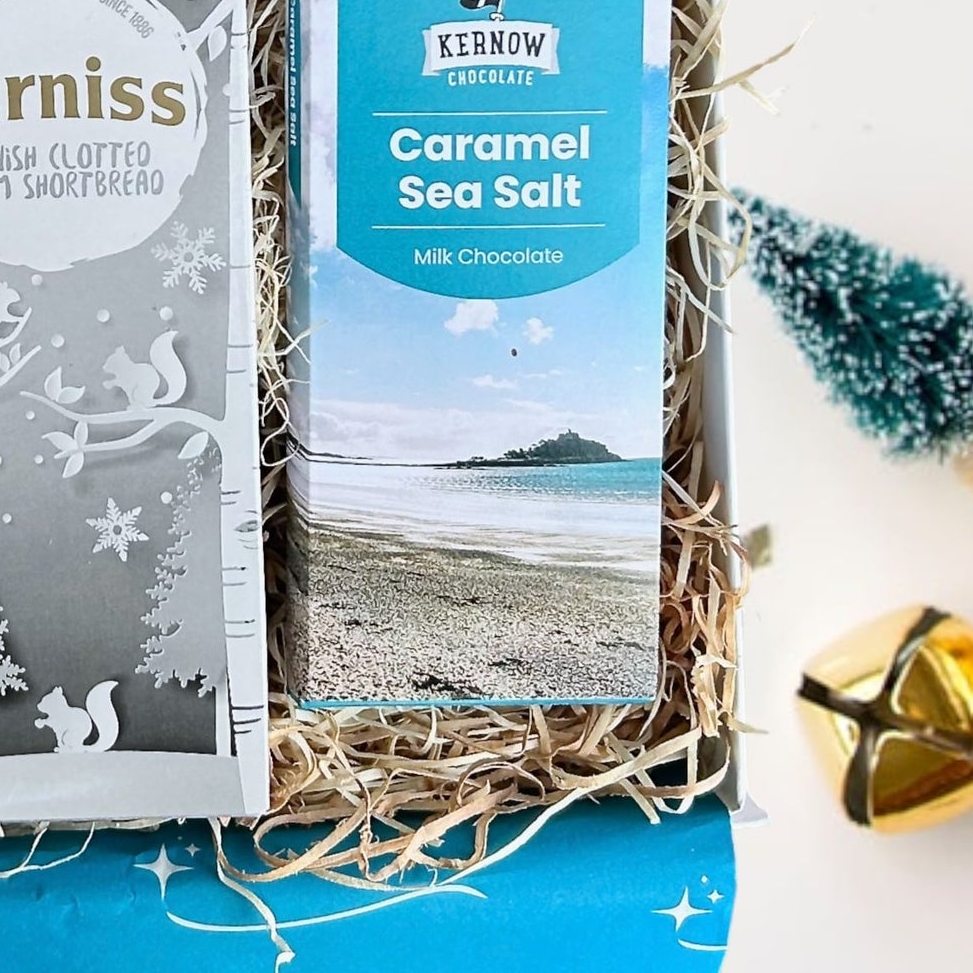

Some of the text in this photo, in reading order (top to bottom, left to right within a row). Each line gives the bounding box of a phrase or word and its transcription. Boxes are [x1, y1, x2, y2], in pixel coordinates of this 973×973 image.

[128, 11, 155, 39] 1886
[437, 30, 546, 59] KERNOW
[289, 75, 297, 109] Sea
[447, 69, 534, 87] CHOCOLATE
[289, 111, 297, 147] Salt
[389, 124, 590, 162] Caramel
[48, 141, 151, 170] CLOTTED
[23, 169, 164, 200] SHORTBREAD
[398, 173, 582, 210] Sea Salt
[413, 247, 564, 265] Milk Chocolate
